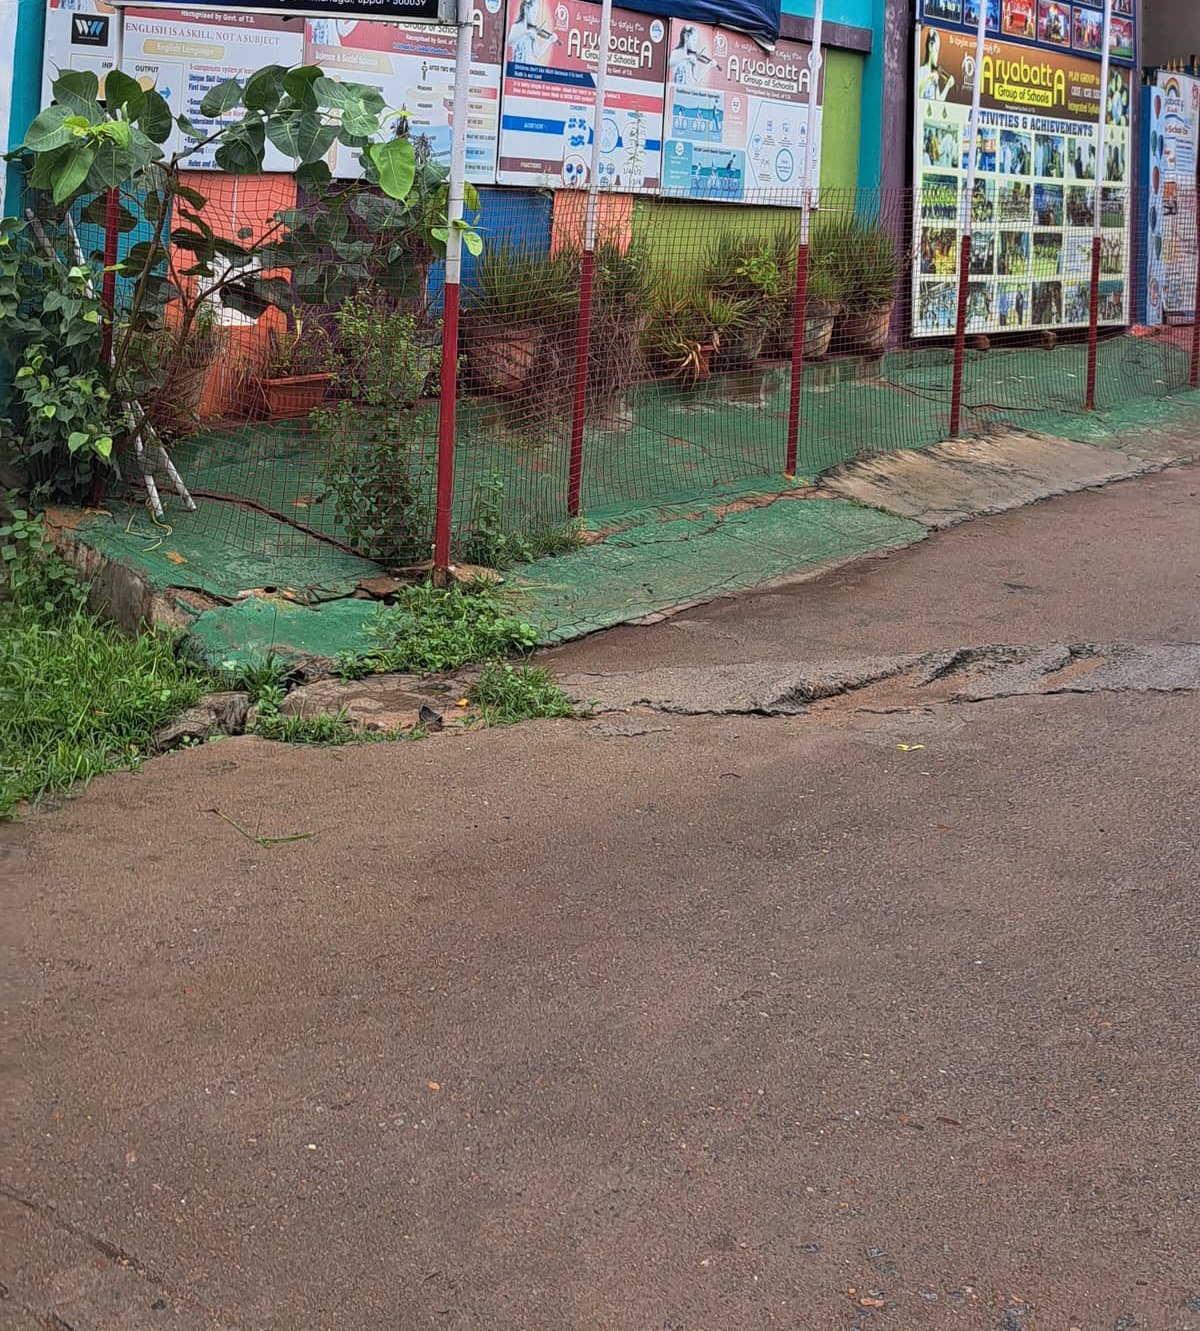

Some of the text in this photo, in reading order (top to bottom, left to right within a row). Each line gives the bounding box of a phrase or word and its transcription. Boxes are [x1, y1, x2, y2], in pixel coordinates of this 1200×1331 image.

[125, 22, 280, 45] ENGLISH IS A SKILL, NOT A SUBJECT
[156, 43, 181, 54] English
[135, 65, 159, 74] OUTPUT
[727, 54, 811, 93] AryabattA
[743, 74, 795, 91] Group of Schools
[981, 55, 1066, 106] AryabattA
[997, 85, 1050, 104] Group of Schools
[1021, 116, 1094, 137] & ACHIEVEMENTS
